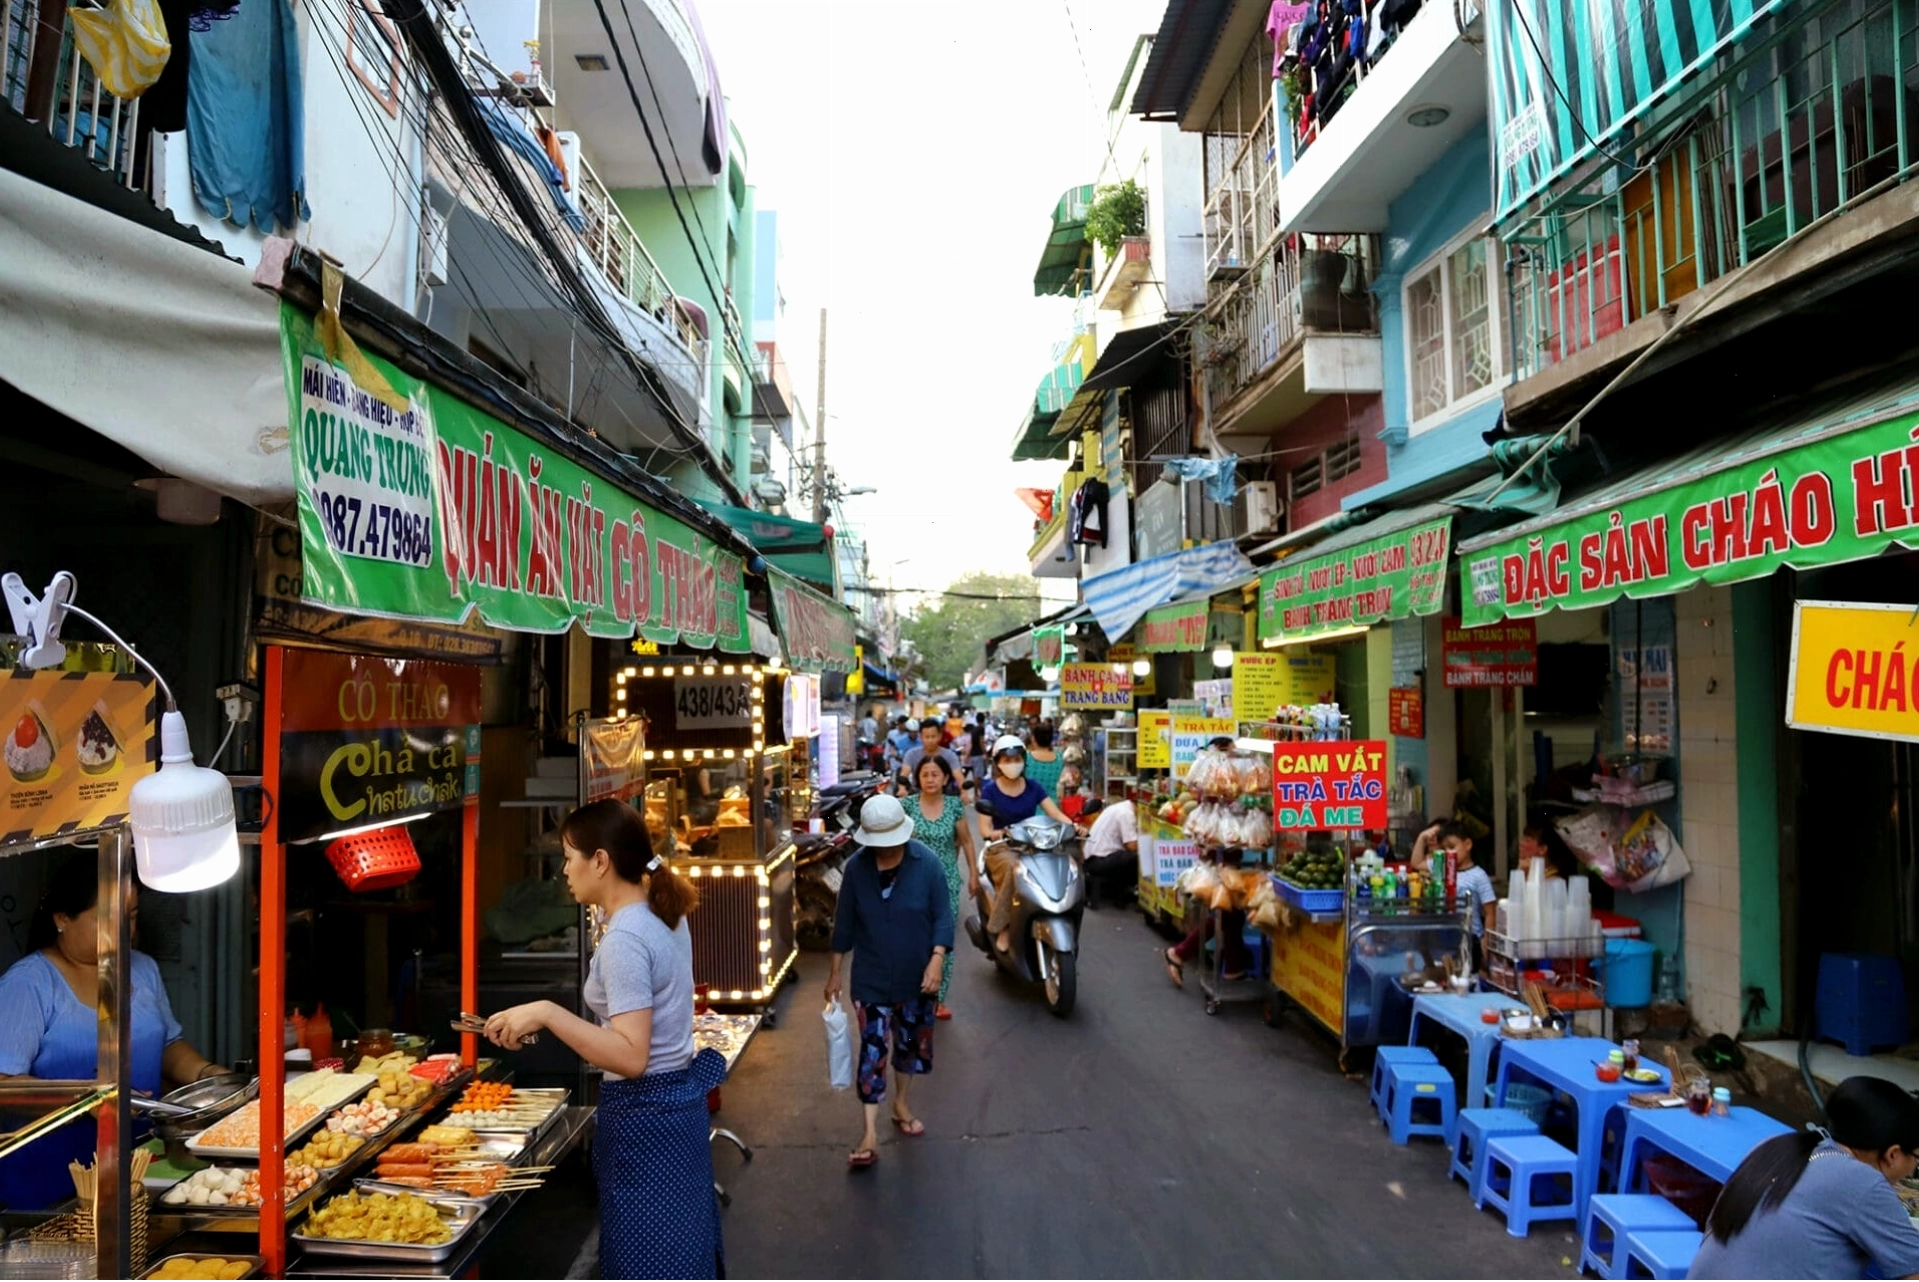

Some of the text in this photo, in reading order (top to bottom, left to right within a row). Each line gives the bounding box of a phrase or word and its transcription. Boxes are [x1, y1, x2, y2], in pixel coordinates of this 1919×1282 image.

[326, 372, 346, 408] HIÊN
[304, 407, 431, 500] QUANG TRUNG
[436, 431, 522, 599] QUÁN
[526, 453, 566, 599] ĂN
[567, 480, 605, 628] VẶT
[610, 508, 651, 625] CÔ
[655, 533, 718, 637] THẢO
[1503, 535, 1571, 611] ĐẶC
[1580, 511, 1669, 593] SẢN
[1682, 467, 1837, 572] CHÁO
[338, 669, 450, 722] CÔ THẢO
[1825, 640, 1919, 713] CHÁ
[1277, 746, 1383, 775] CAM VẮT
[1277, 772, 1383, 802] TRÀ TẮC
[1279, 802, 1364, 828] ĐÁ ME
